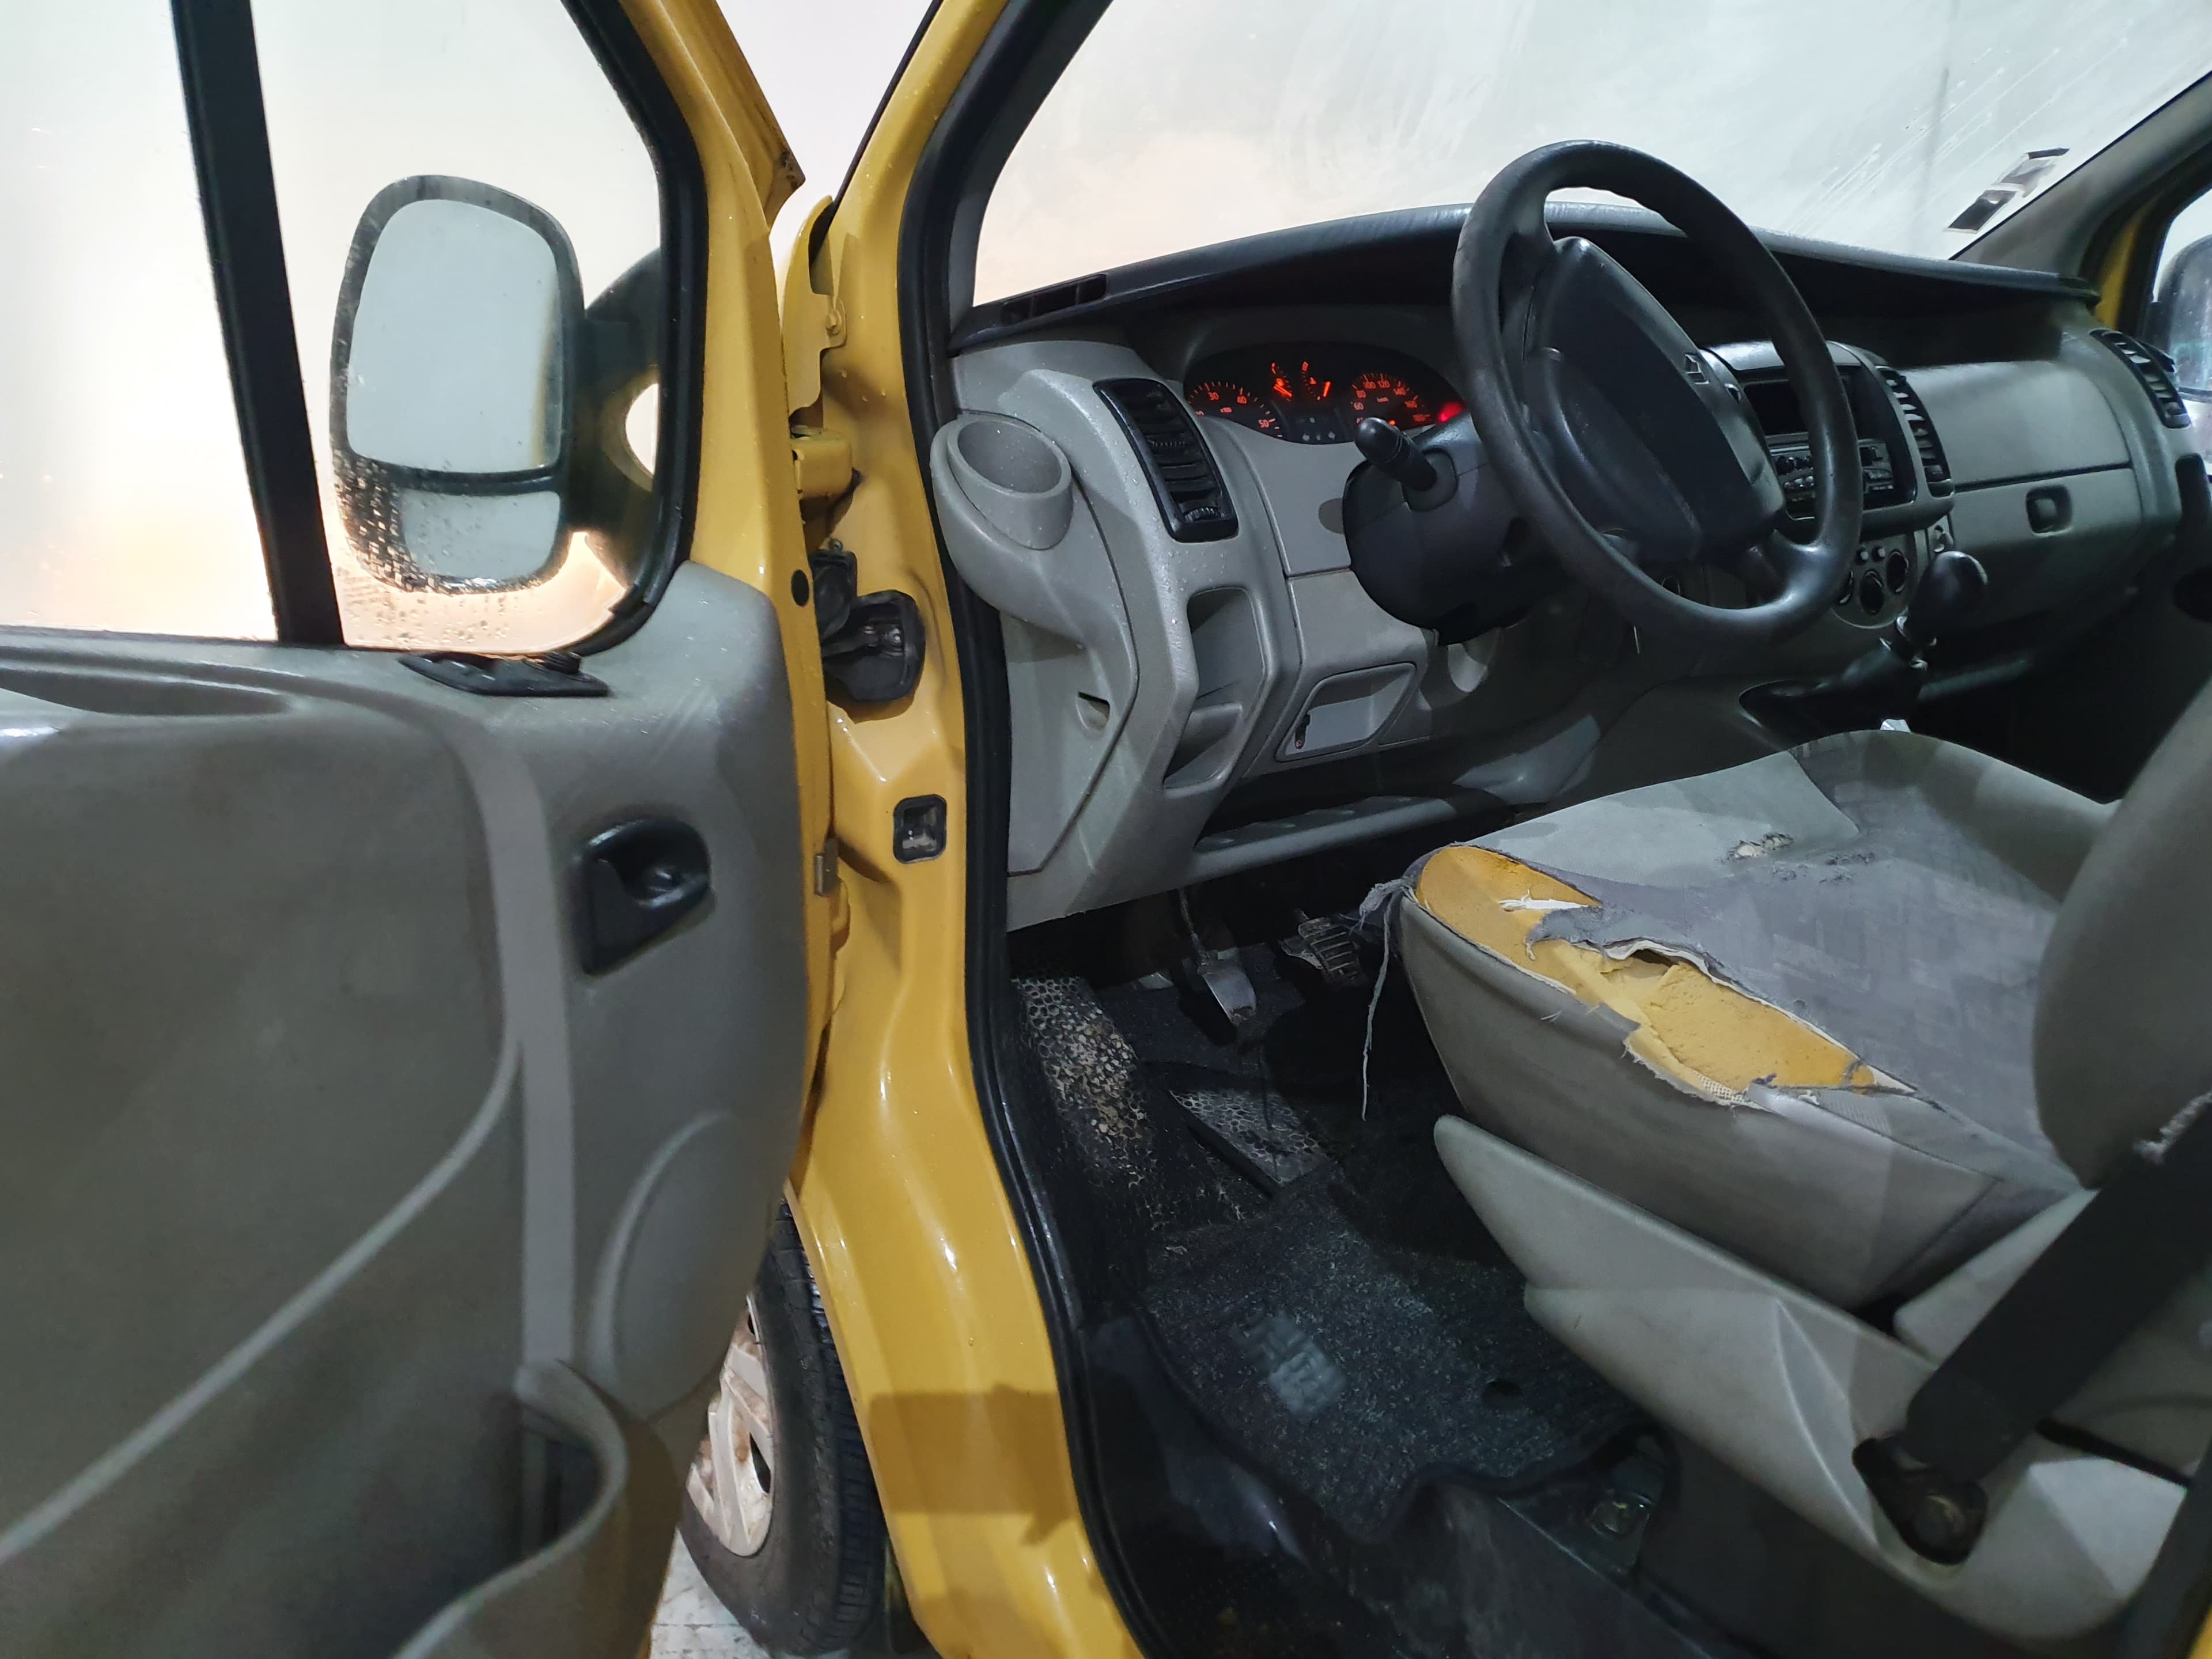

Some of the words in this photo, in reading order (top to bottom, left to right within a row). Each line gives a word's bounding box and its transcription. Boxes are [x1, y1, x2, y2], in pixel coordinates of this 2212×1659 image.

[1208, 392, 1219, 400] 30
[1354, 402, 1364, 410] 60
[1258, 419, 1269, 428] 50
